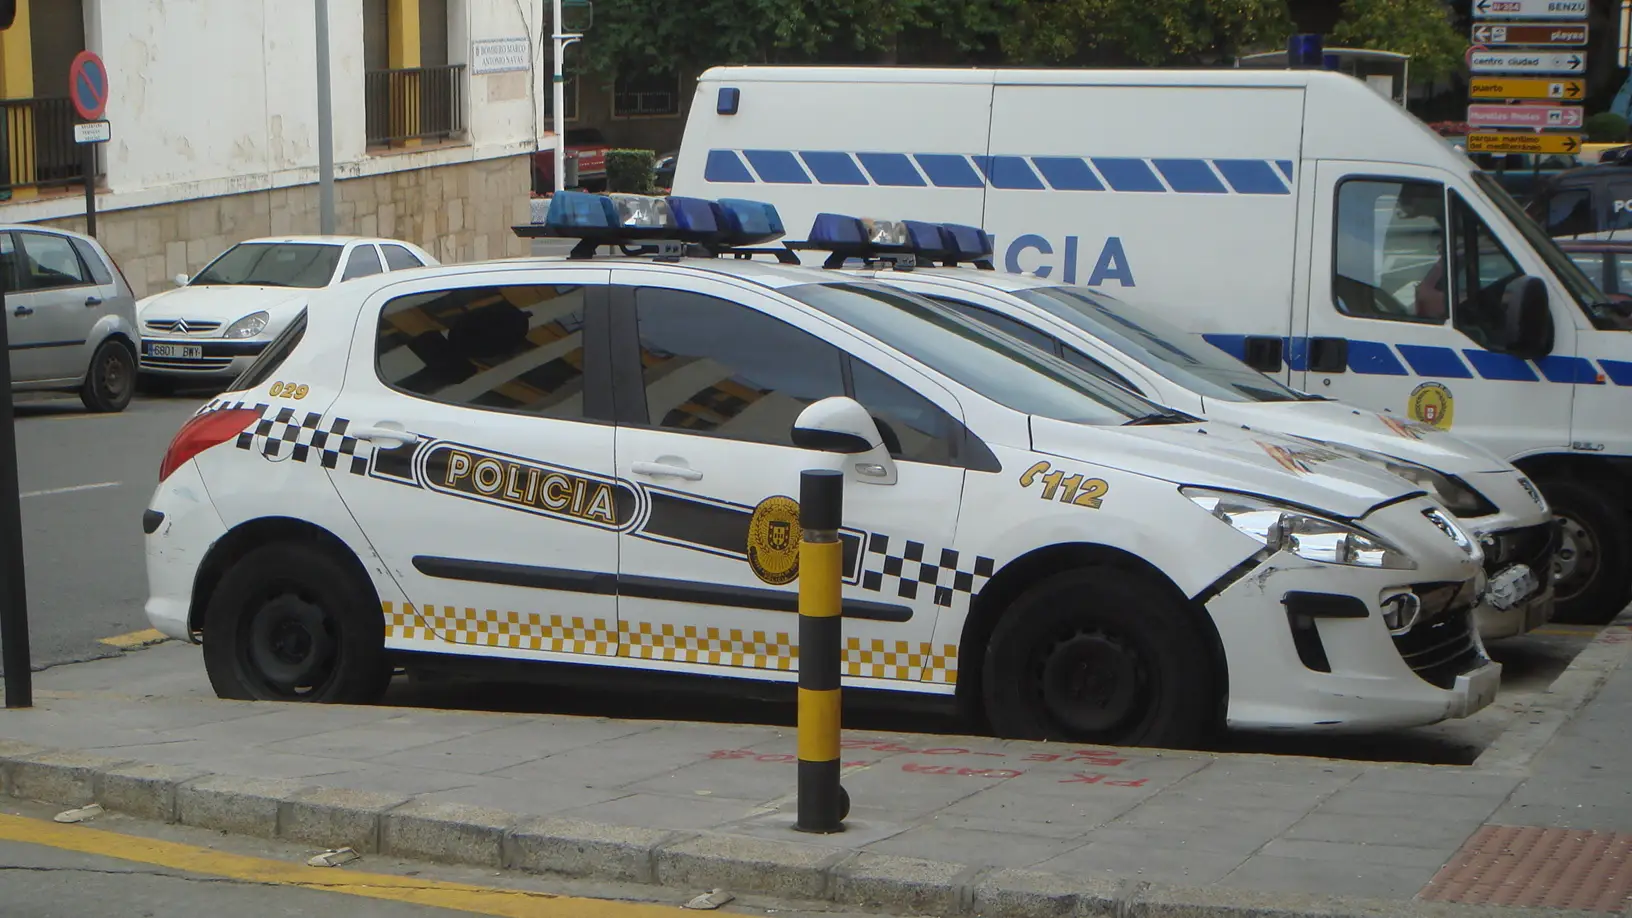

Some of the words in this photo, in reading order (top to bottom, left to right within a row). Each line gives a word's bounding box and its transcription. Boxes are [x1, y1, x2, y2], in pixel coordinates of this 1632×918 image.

[1551, 29, 1584, 41] playas
[1473, 57, 1503, 66] centro
[1508, 56, 1539, 66] ciudad
[1472, 84, 1503, 93] puerto
[1470, 135, 1498, 143] parque
[154, 345, 175, 356] 6801
[269, 380, 310, 401] 029
[444, 450, 616, 524] POLICIA
[1040, 469, 1109, 510] 112
